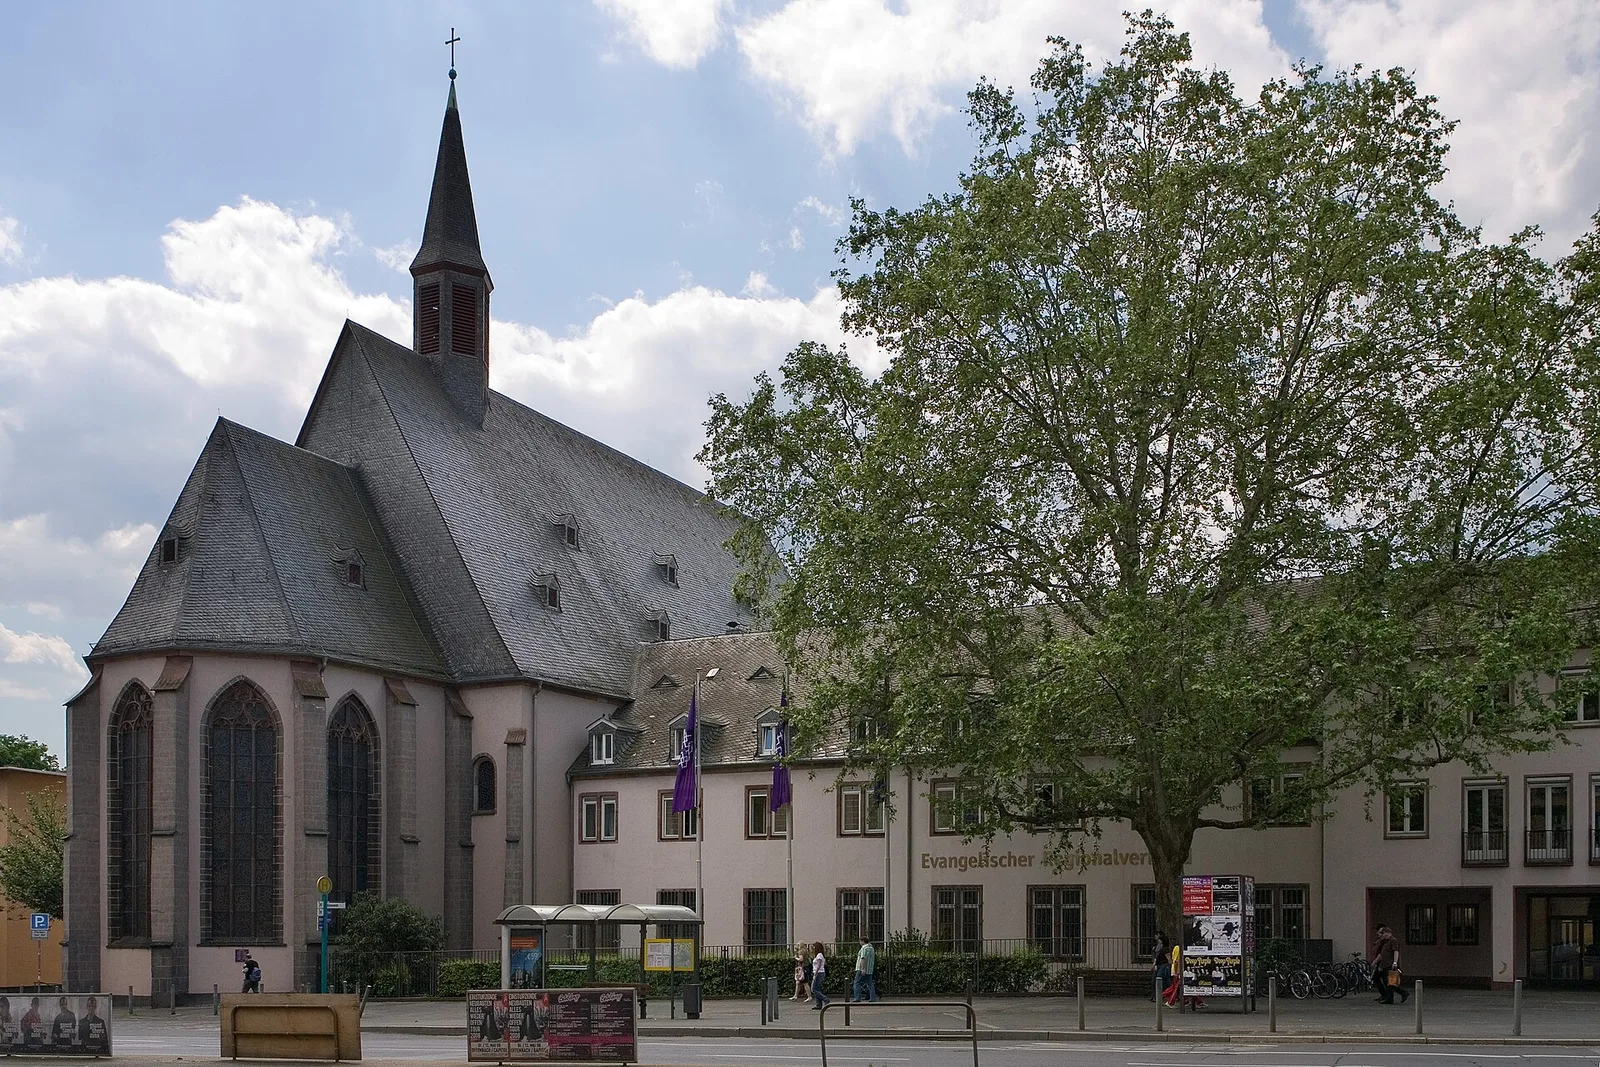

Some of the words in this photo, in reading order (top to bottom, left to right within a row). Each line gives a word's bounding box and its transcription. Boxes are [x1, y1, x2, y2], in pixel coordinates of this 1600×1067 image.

[921, 851, 1035, 872] Evangelischer
[322, 881, 328, 890] H
[35, 915, 45, 928] P
